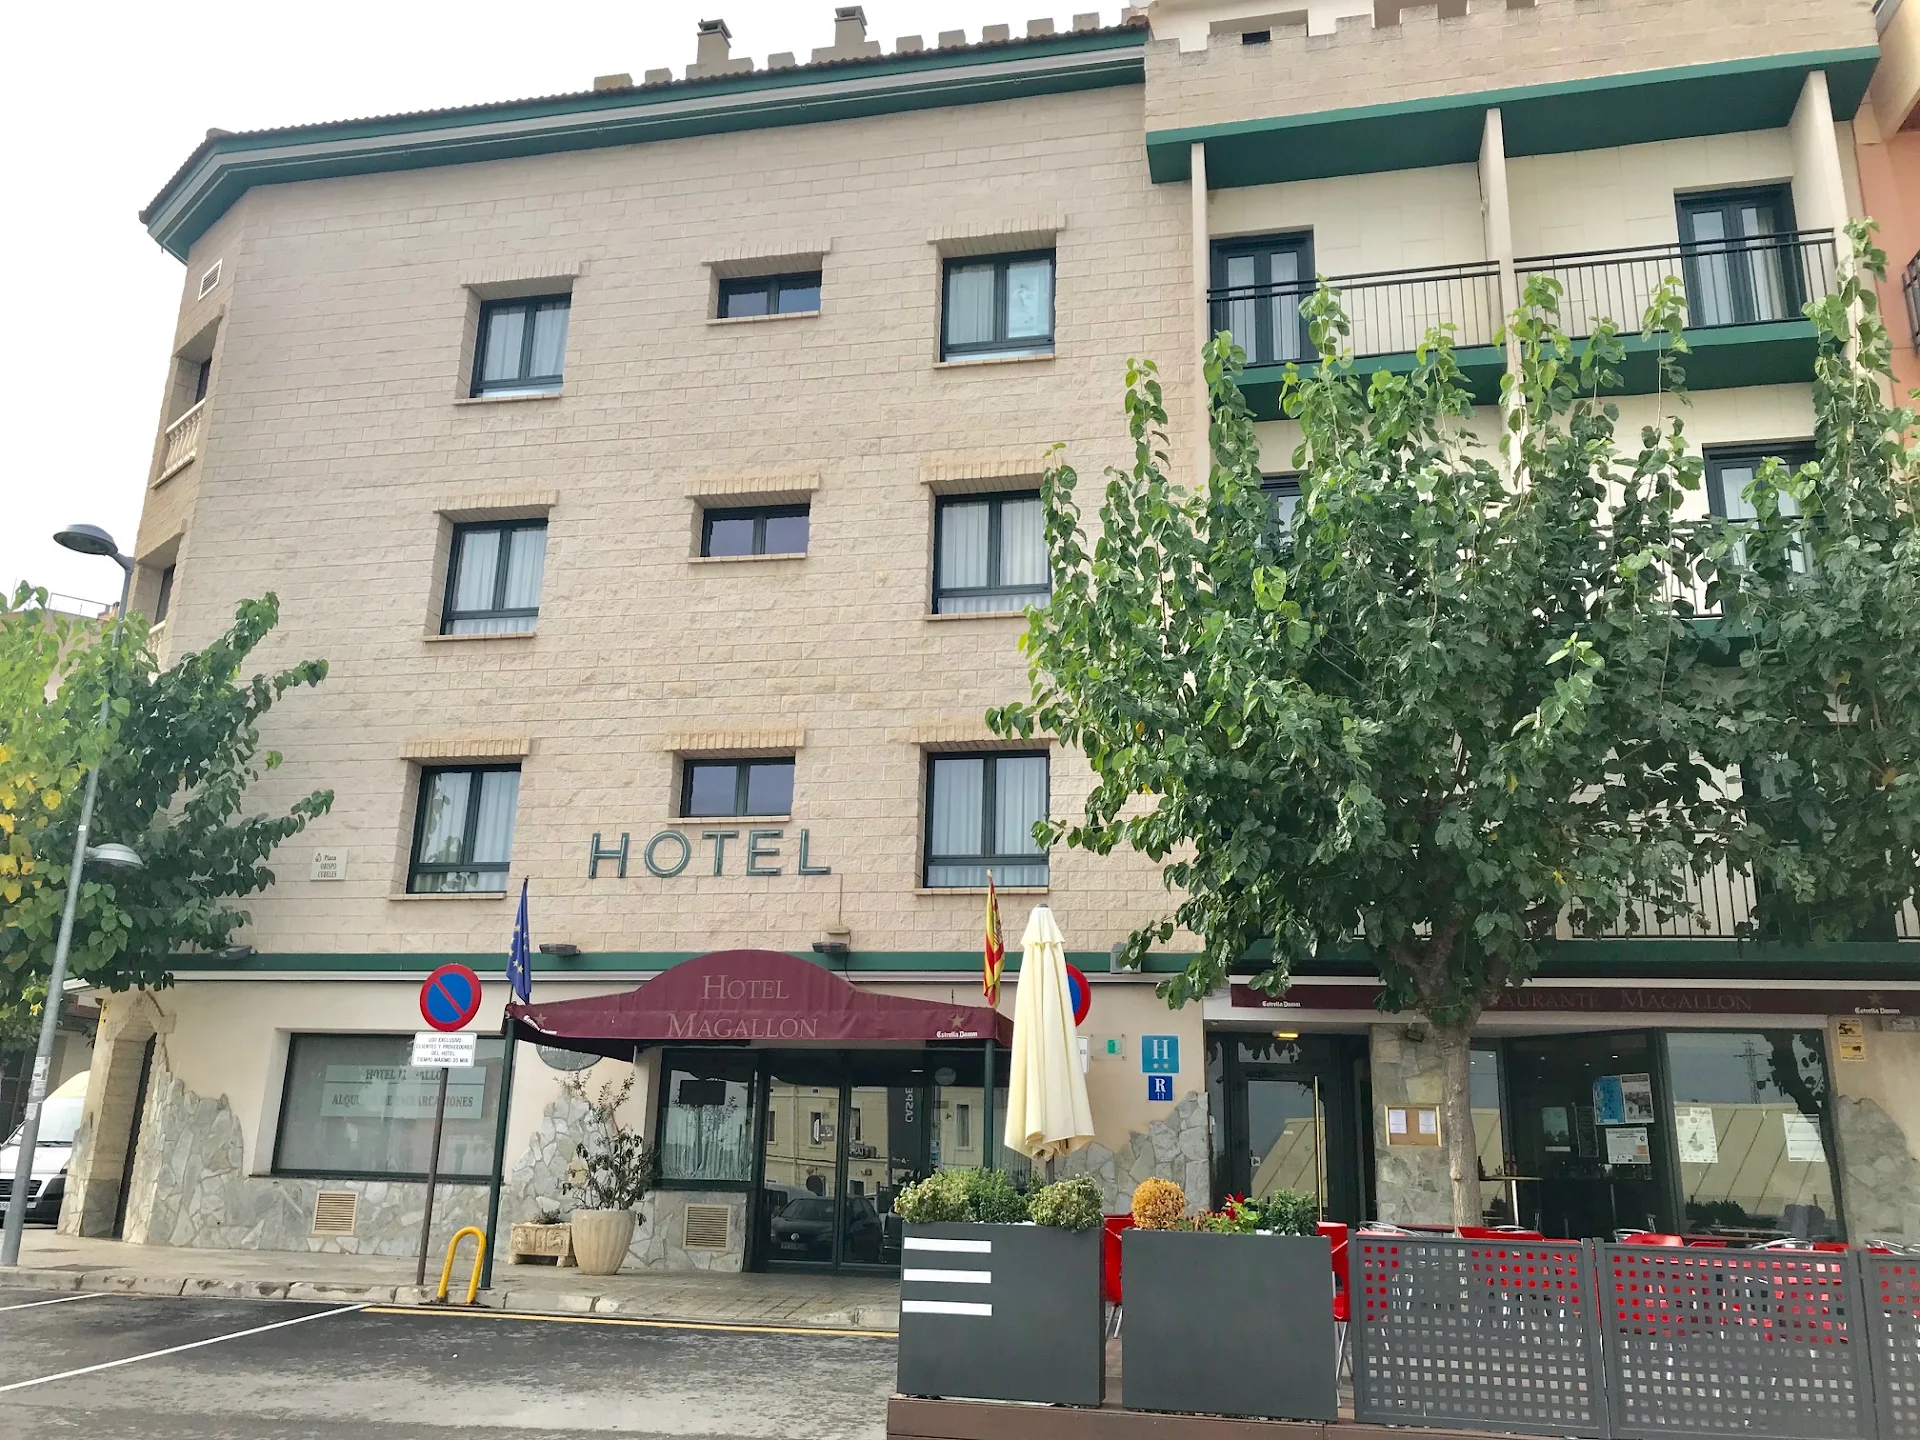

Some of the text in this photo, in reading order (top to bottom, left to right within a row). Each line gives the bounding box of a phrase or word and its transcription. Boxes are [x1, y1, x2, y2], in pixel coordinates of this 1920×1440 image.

[588, 829, 831, 879] HOTEL
[701, 974, 789, 1000] HOTEL
[936, 1030, 978, 1038] Estrella Damm
[1153, 1040, 1169, 1059] H
[1155, 1078, 1166, 1093] R
